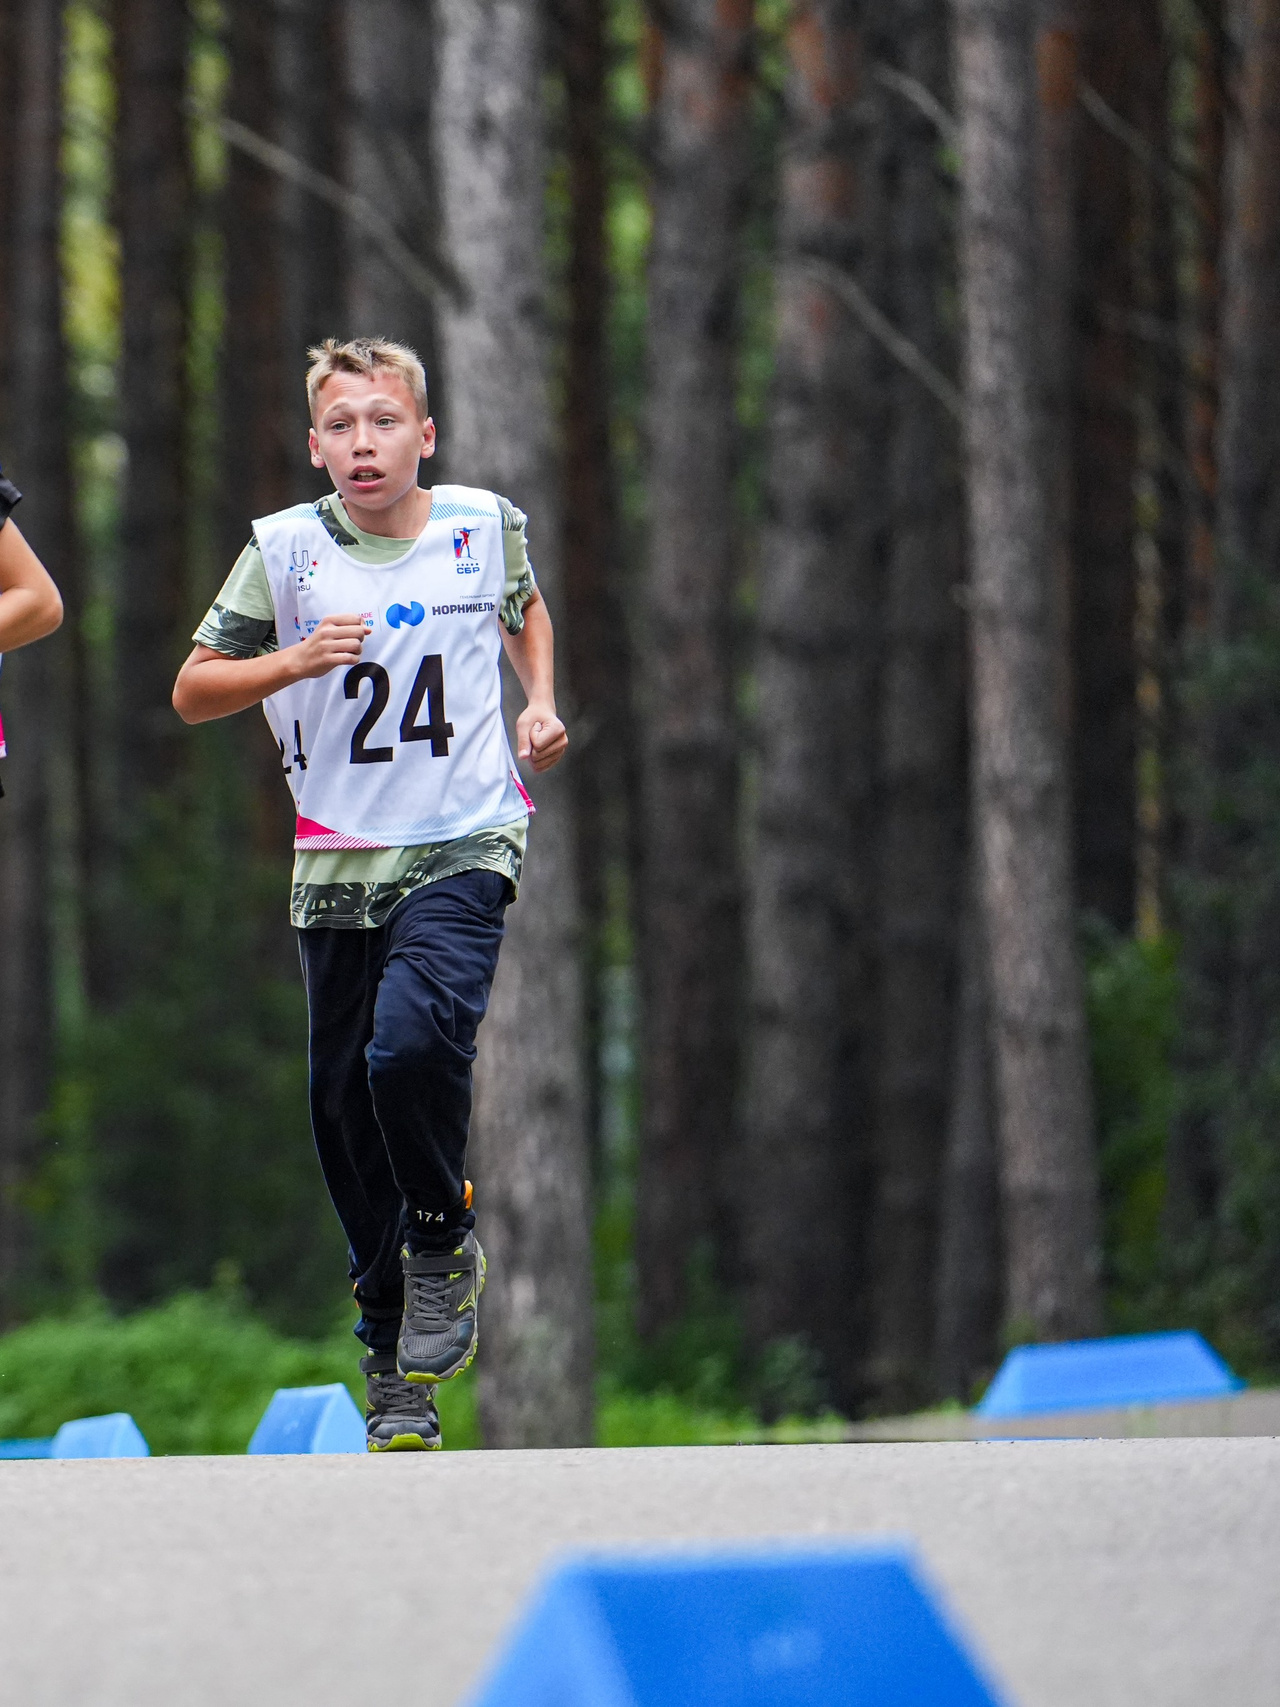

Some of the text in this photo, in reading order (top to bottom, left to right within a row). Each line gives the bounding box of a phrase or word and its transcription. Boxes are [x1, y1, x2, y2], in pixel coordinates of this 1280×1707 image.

[456, 566, 480, 575] СБР
[432, 602, 496, 616] НОРНИКЕЛЬ
[344, 654, 455, 764] 24
[416, 1210, 445, 1222] 174
